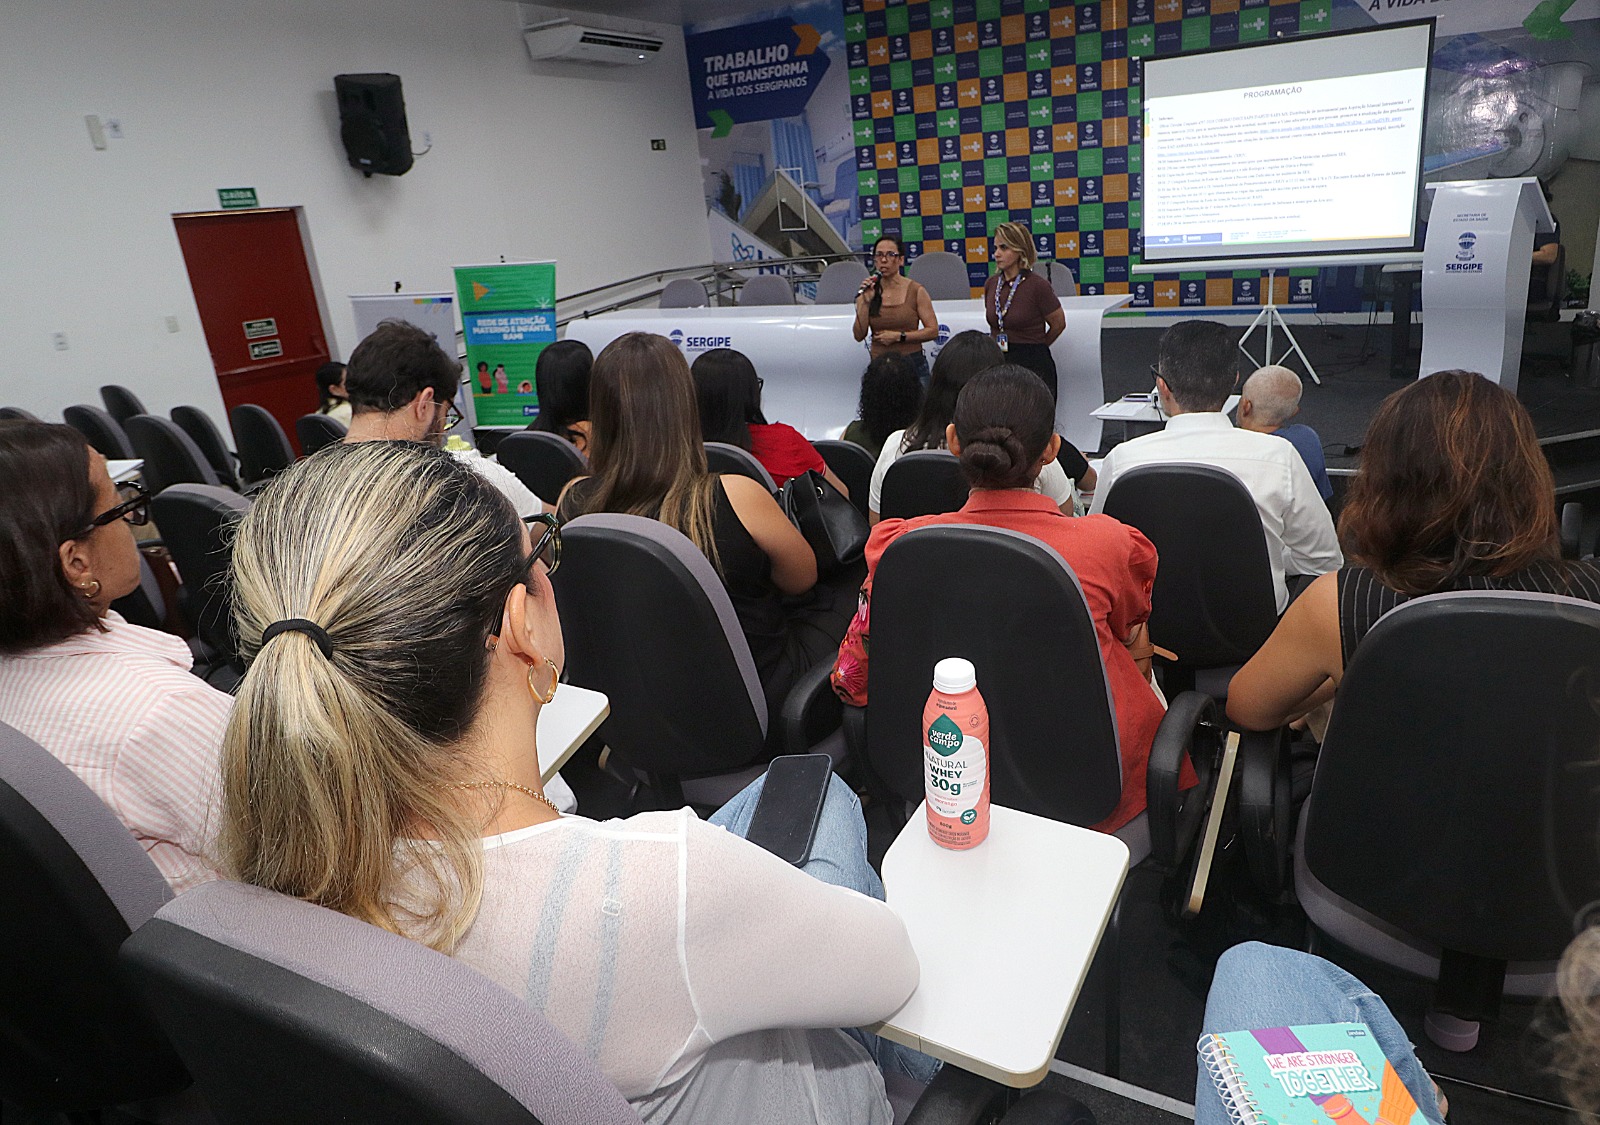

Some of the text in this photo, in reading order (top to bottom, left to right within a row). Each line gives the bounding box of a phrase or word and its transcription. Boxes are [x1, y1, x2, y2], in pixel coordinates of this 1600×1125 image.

[704, 44, 788, 73] TRABALHO
[706, 61, 808, 89] QUE TRANSFORMA
[708, 76, 808, 100] A VIDA DOS SERGIPANOS
[1244, 86, 1302, 99] PROGRAMAÇÃO
[510, 316, 546, 325] ATENÇÃO
[686, 336, 731, 347] SERGIPE
[930, 735, 960, 748] campo
[932, 730, 957, 741] verde
[925, 751, 968, 769] NATURAL
[930, 763, 962, 779] WHEY
[931, 774, 961, 796] 30g
[1267, 1052, 1358, 1069] WE ARE STRONGER
[1274, 1066, 1373, 1094] TOGETHER
